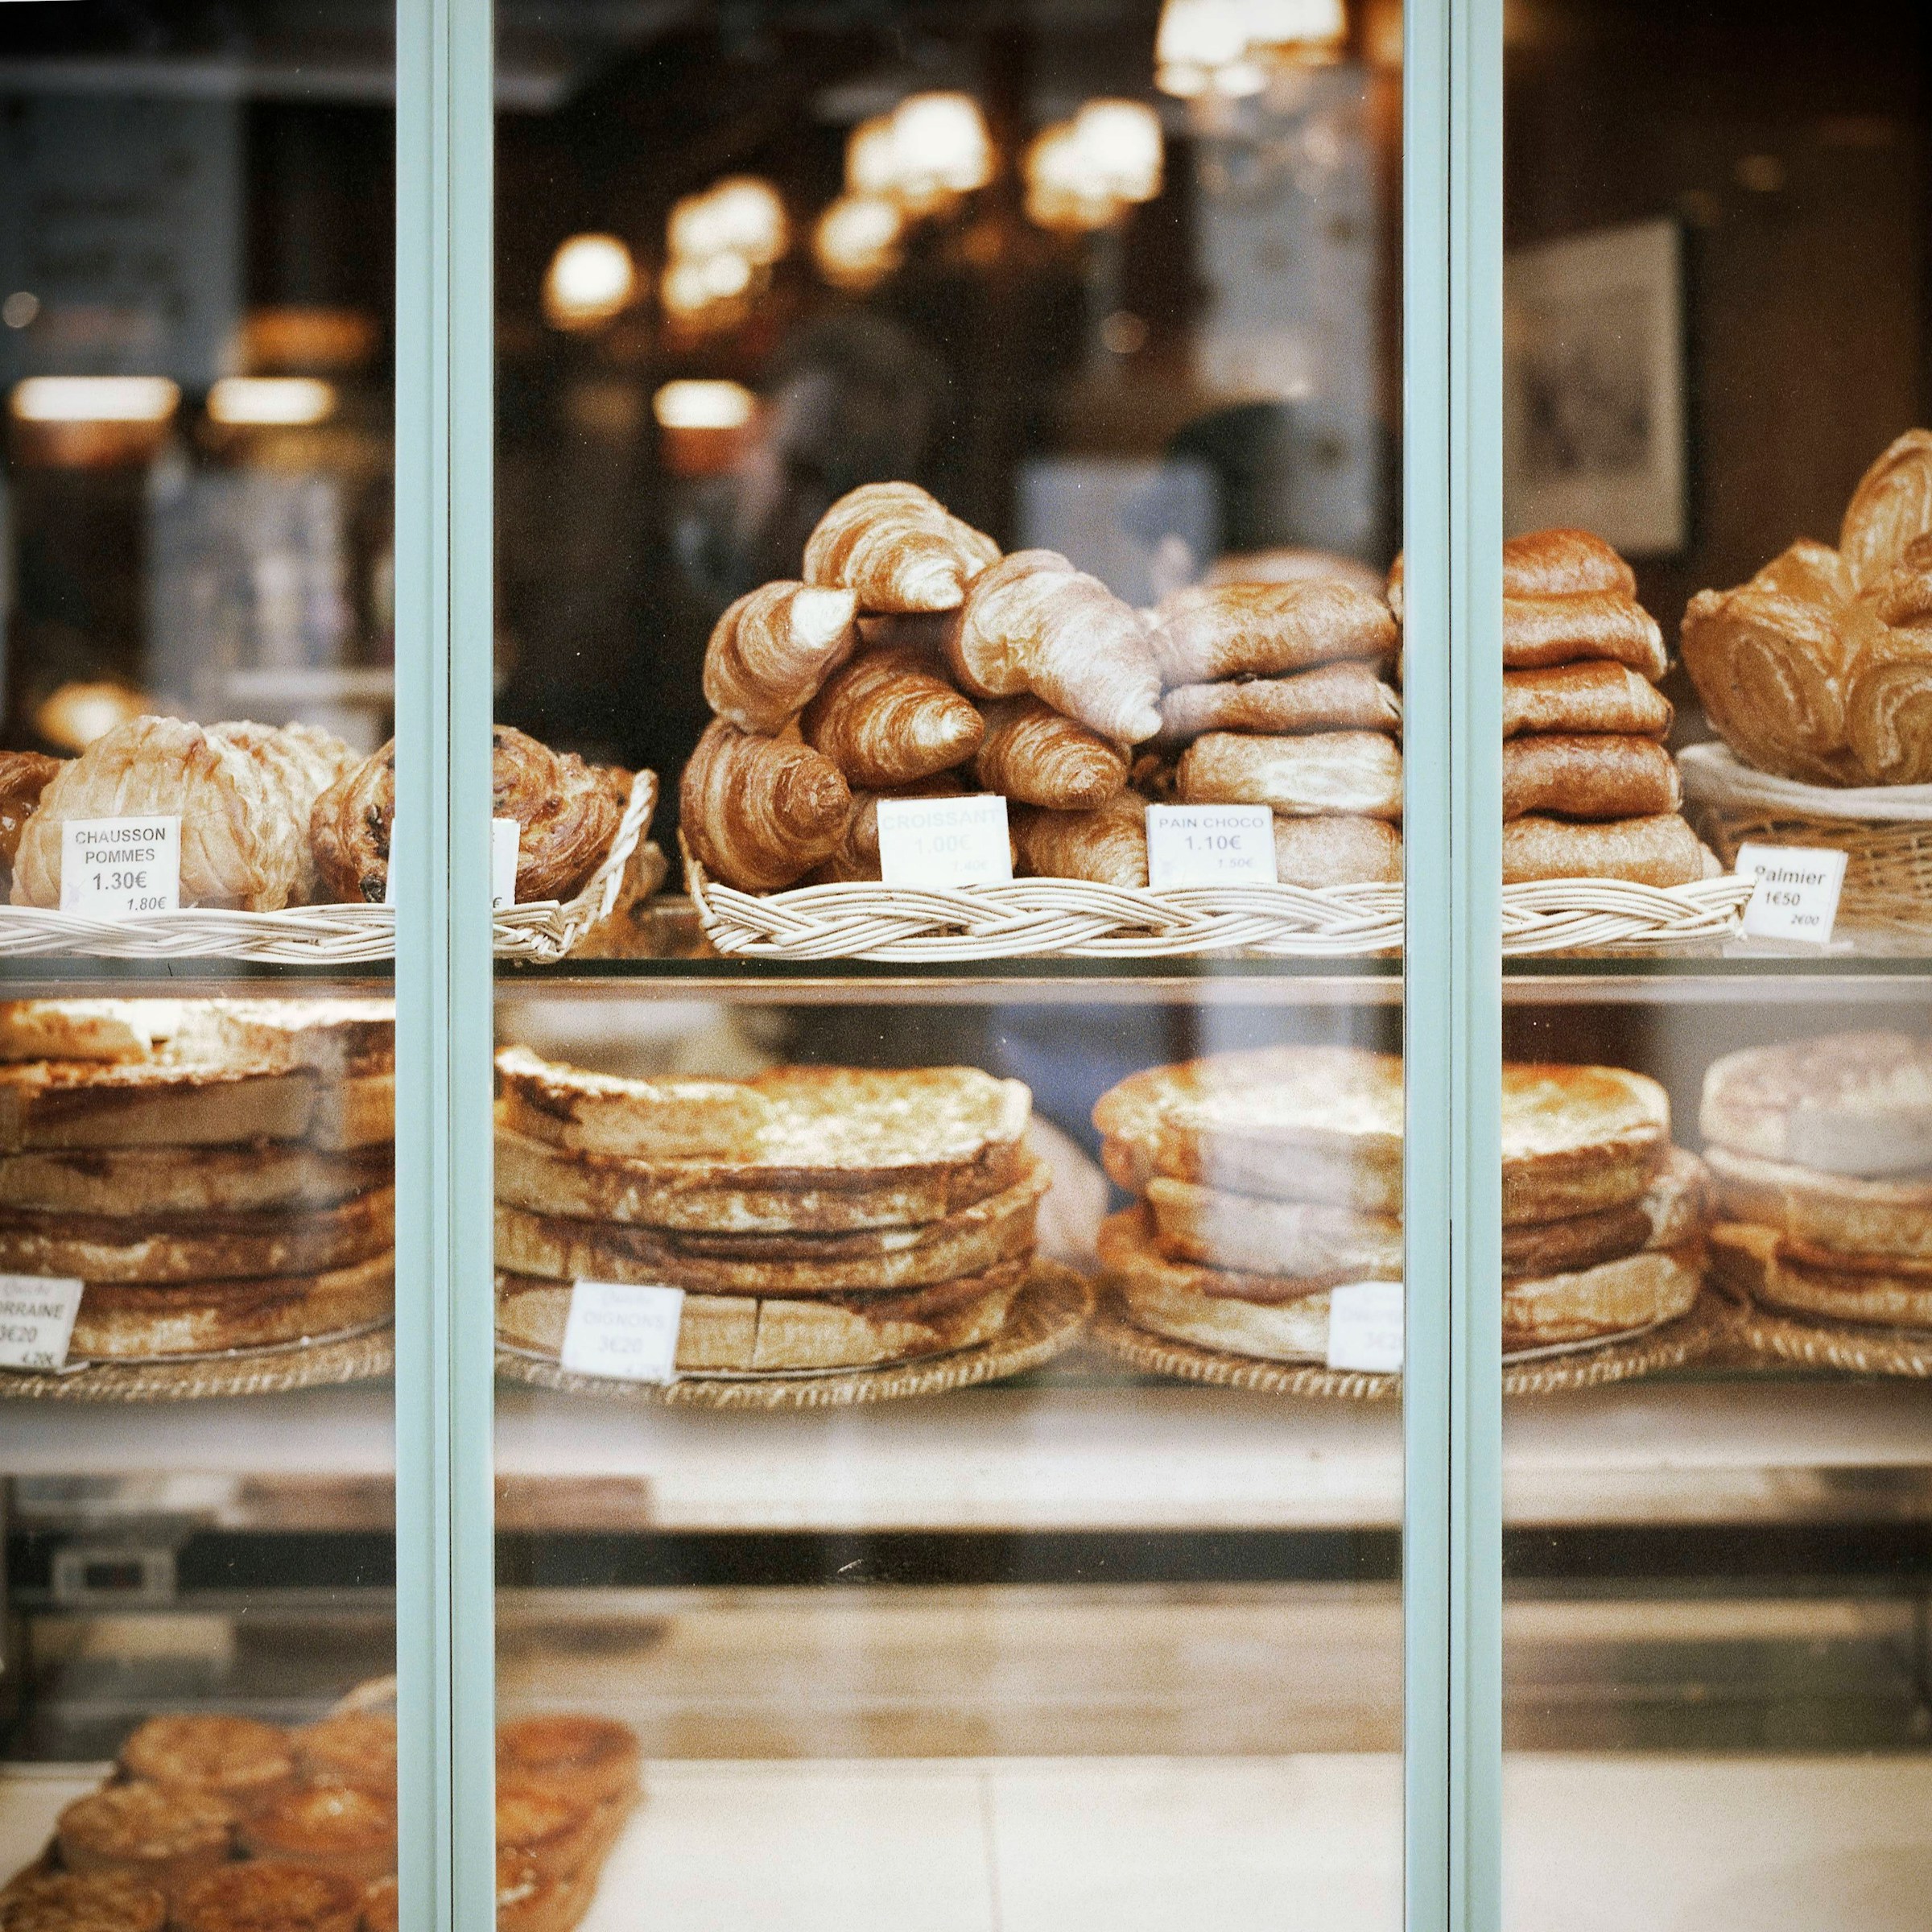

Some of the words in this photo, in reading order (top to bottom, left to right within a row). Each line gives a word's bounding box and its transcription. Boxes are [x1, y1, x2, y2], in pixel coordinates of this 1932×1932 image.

[882, 809, 1000, 831] CROISSANT
[1159, 817, 1197, 828] PAIN
[1203, 817, 1264, 828] CHOCO
[76, 828, 166, 844] CHAUSSON
[914, 834, 972, 854] 1.00€
[1185, 835, 1241, 850] 1.10€
[85, 848, 155, 864] POMMES
[1218, 857, 1255, 869] 1.50€
[93, 871, 147, 890] 1.30€
[1755, 865, 1826, 886] Palmier
[127, 897, 167, 910] 1.80€
[1765, 891, 1802, 906] 1€50
[1790, 914, 1819, 926] 2€00
[0, 1301, 64, 1320] RRAINE
[598, 1335, 642, 1353] 3€20
